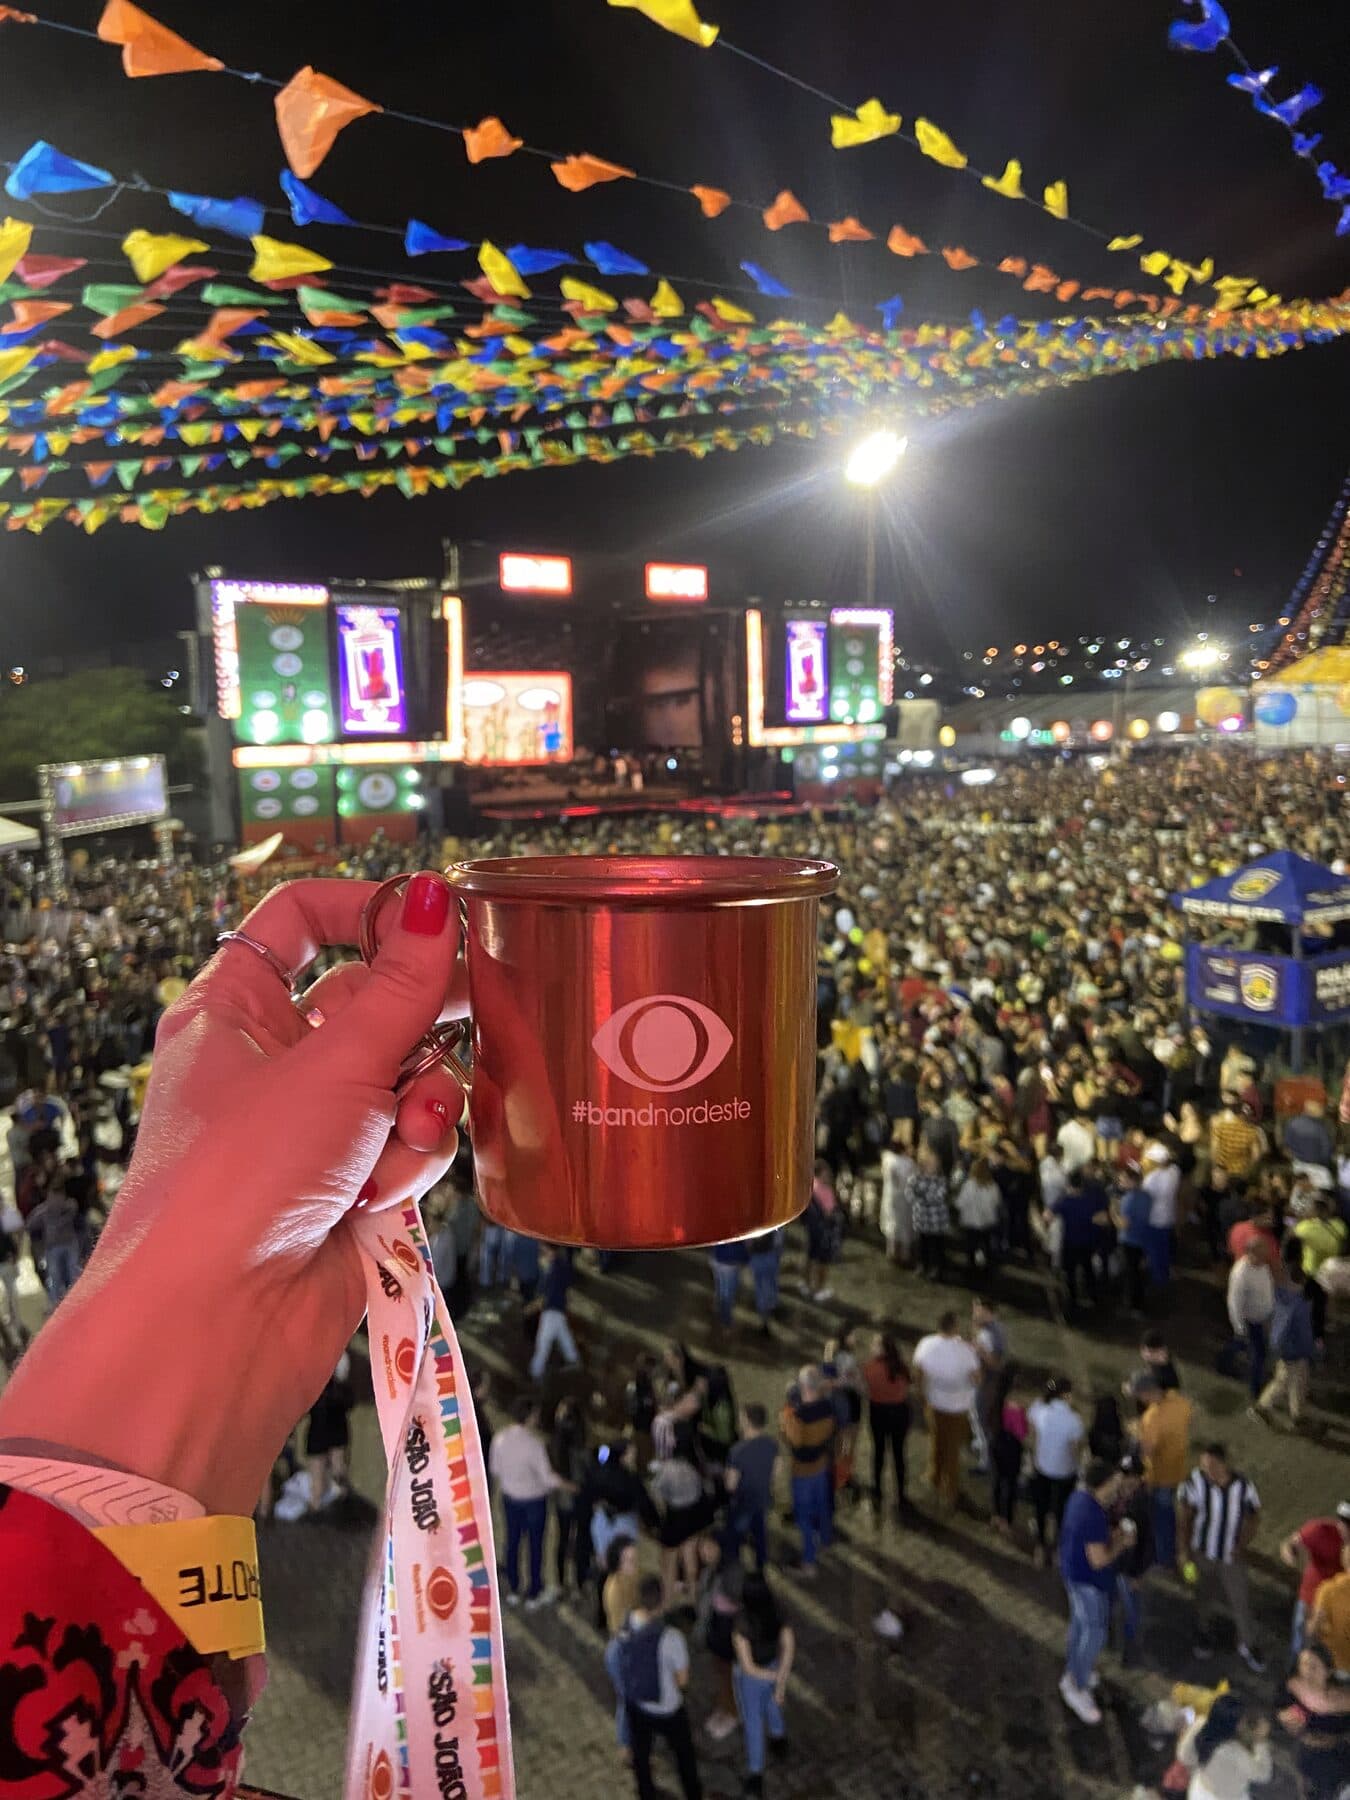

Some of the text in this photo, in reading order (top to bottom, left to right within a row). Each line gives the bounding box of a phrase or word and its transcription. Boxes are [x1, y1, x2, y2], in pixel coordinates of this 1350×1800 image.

[572, 1097, 751, 1126] #bandnordeste
[404, 1426, 431, 1475] SÃO
[411, 1477, 440, 1531] JOÃO
[428, 1671, 458, 1727] SÃO
